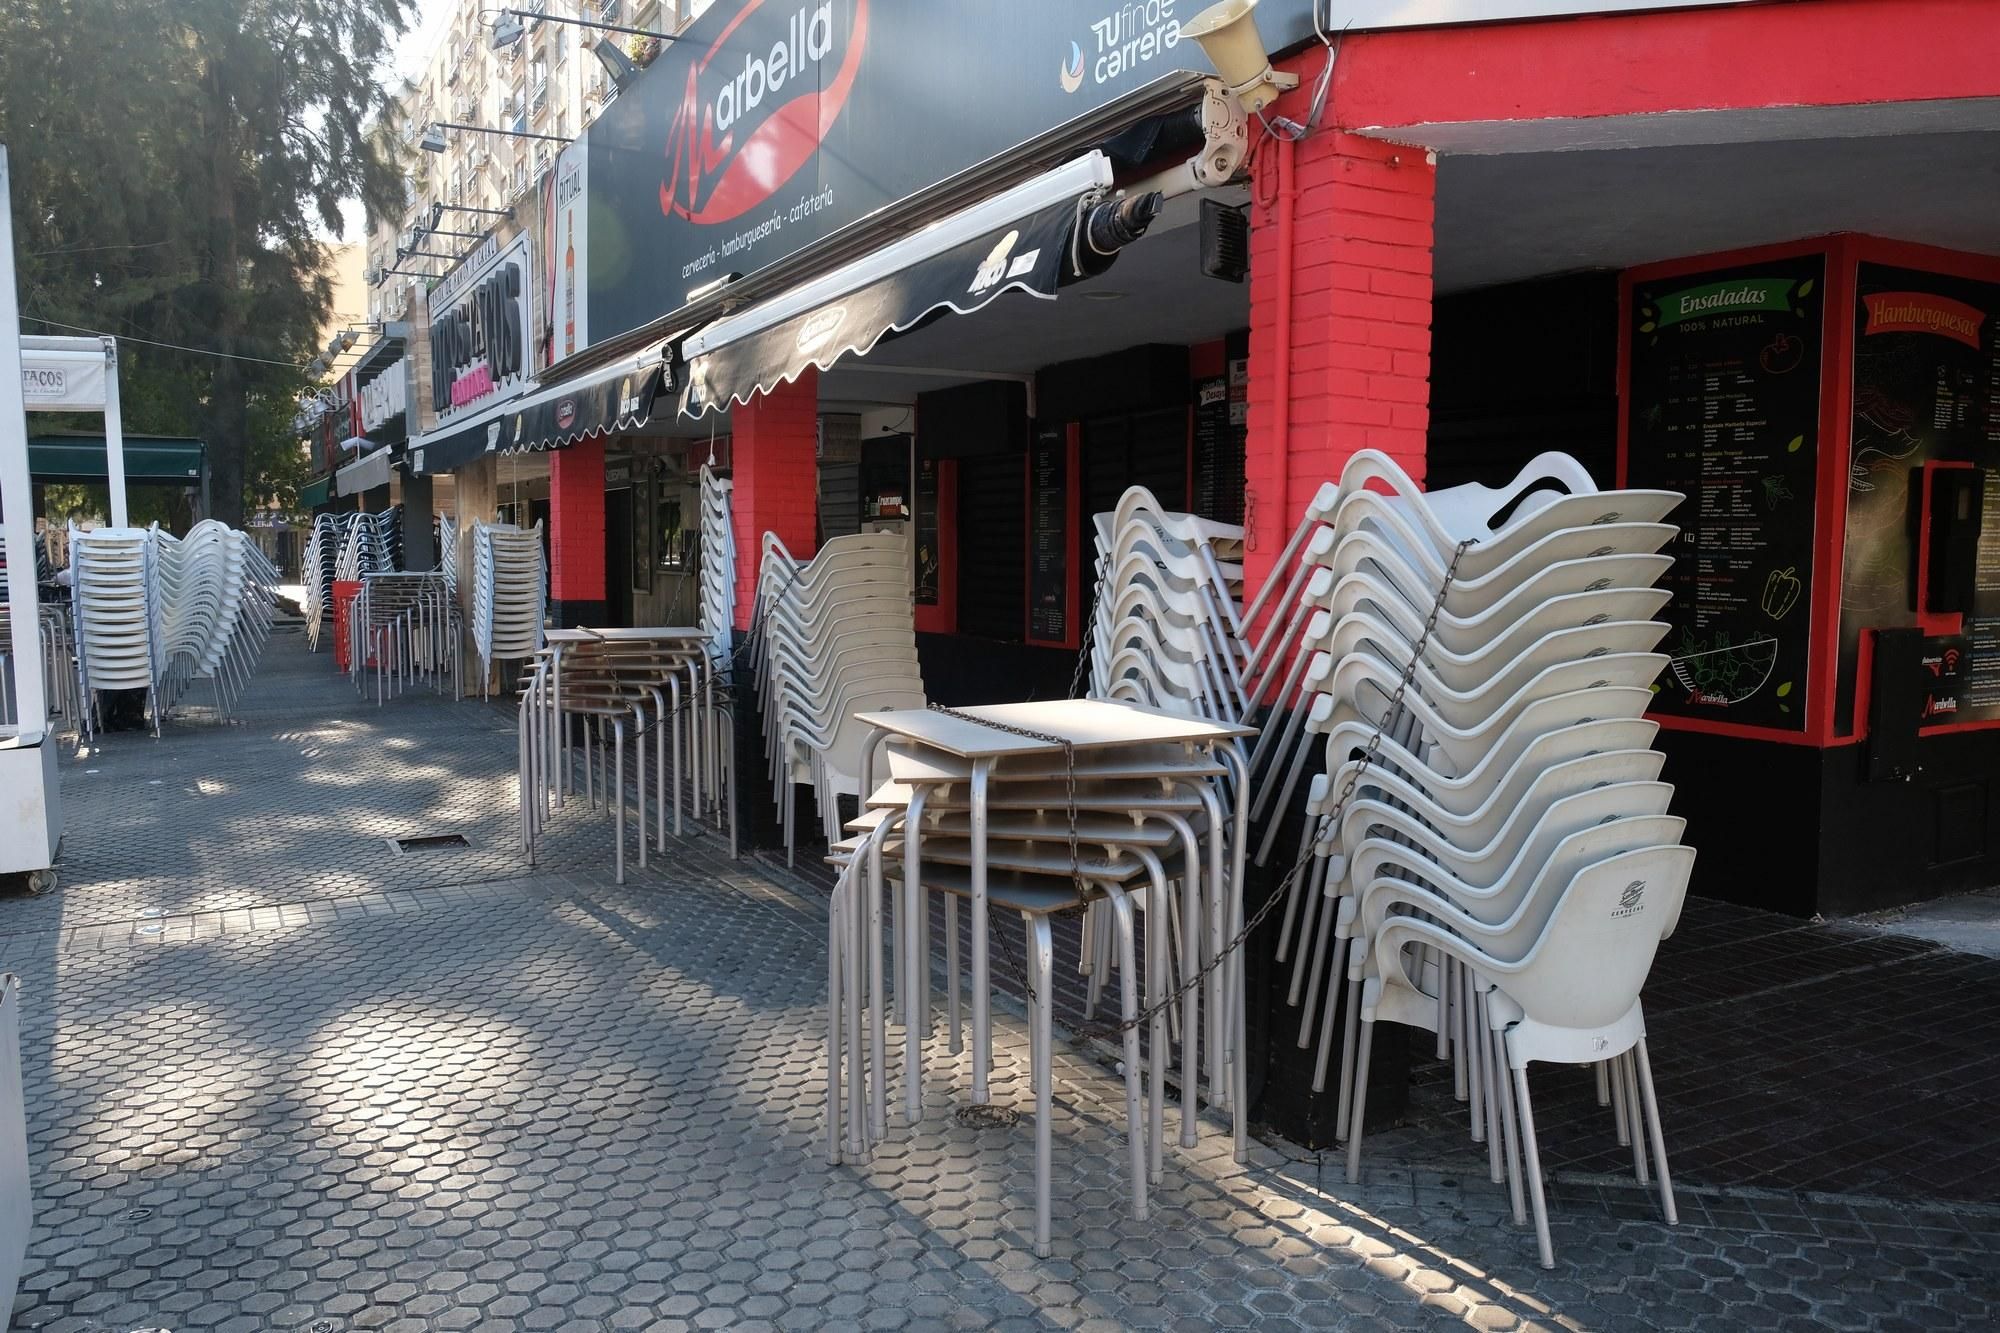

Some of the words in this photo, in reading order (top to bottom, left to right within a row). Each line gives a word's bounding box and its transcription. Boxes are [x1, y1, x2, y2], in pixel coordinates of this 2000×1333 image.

[1094, 19, 1181, 85] carrera
[659, 2, 833, 217] Marbella
[559, 168, 582, 208] RITUAL
[681, 244, 717, 280] cervecería
[721, 209, 782, 259] hamburguesería
[789, 183, 833, 224] cafetería
[1679, 286, 1768, 315] Ensaladas
[1872, 298, 1976, 338] Hamburguesas
[1679, 321, 1706, 333] 100%
[1712, 314, 1764, 329] NATURAL
